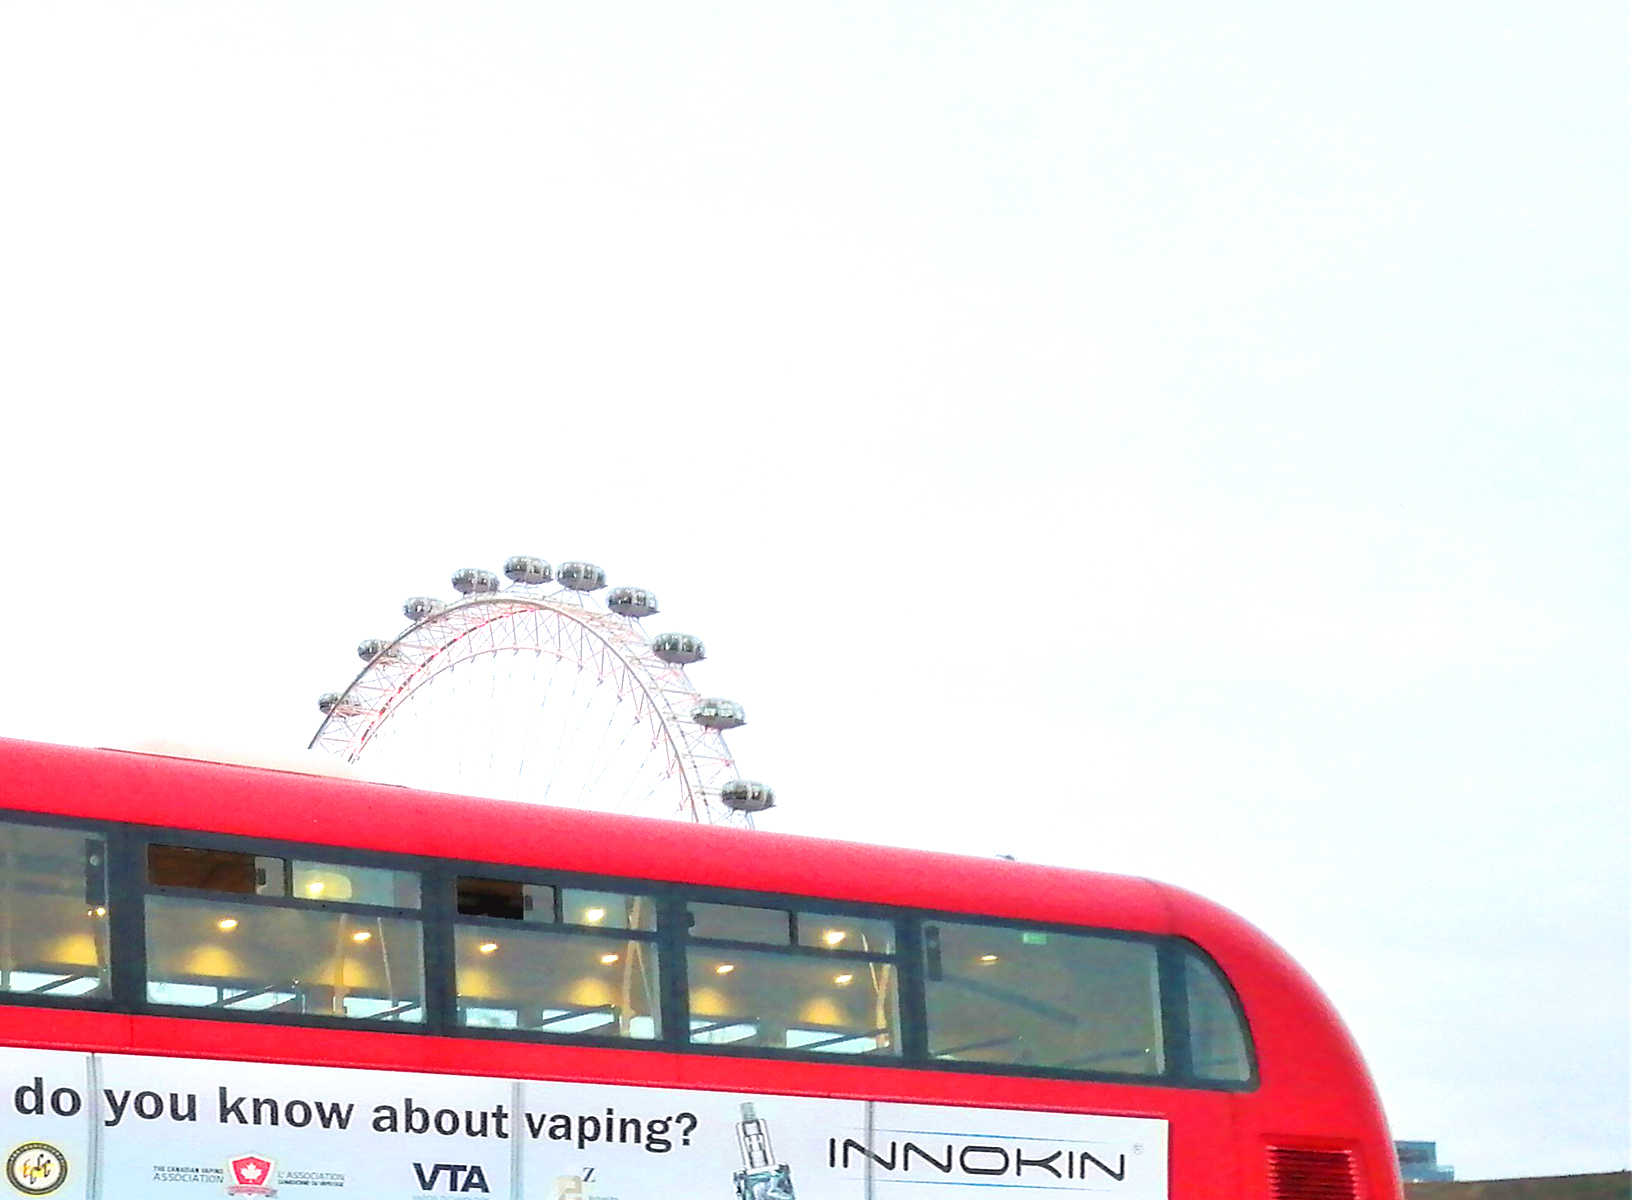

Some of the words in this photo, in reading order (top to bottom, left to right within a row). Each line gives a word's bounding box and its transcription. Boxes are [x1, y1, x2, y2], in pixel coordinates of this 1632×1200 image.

[14, 1076, 81, 1117] do
[103, 1089, 197, 1127] you
[219, 1086, 354, 1130] know
[372, 1098, 509, 1139] about
[525, 1112, 698, 1153] vaping?
[153, 1172, 225, 1184] ASSOCIATION
[412, 1162, 490, 1194] VTA
[829, 1137, 1126, 1182] INNOKIN
